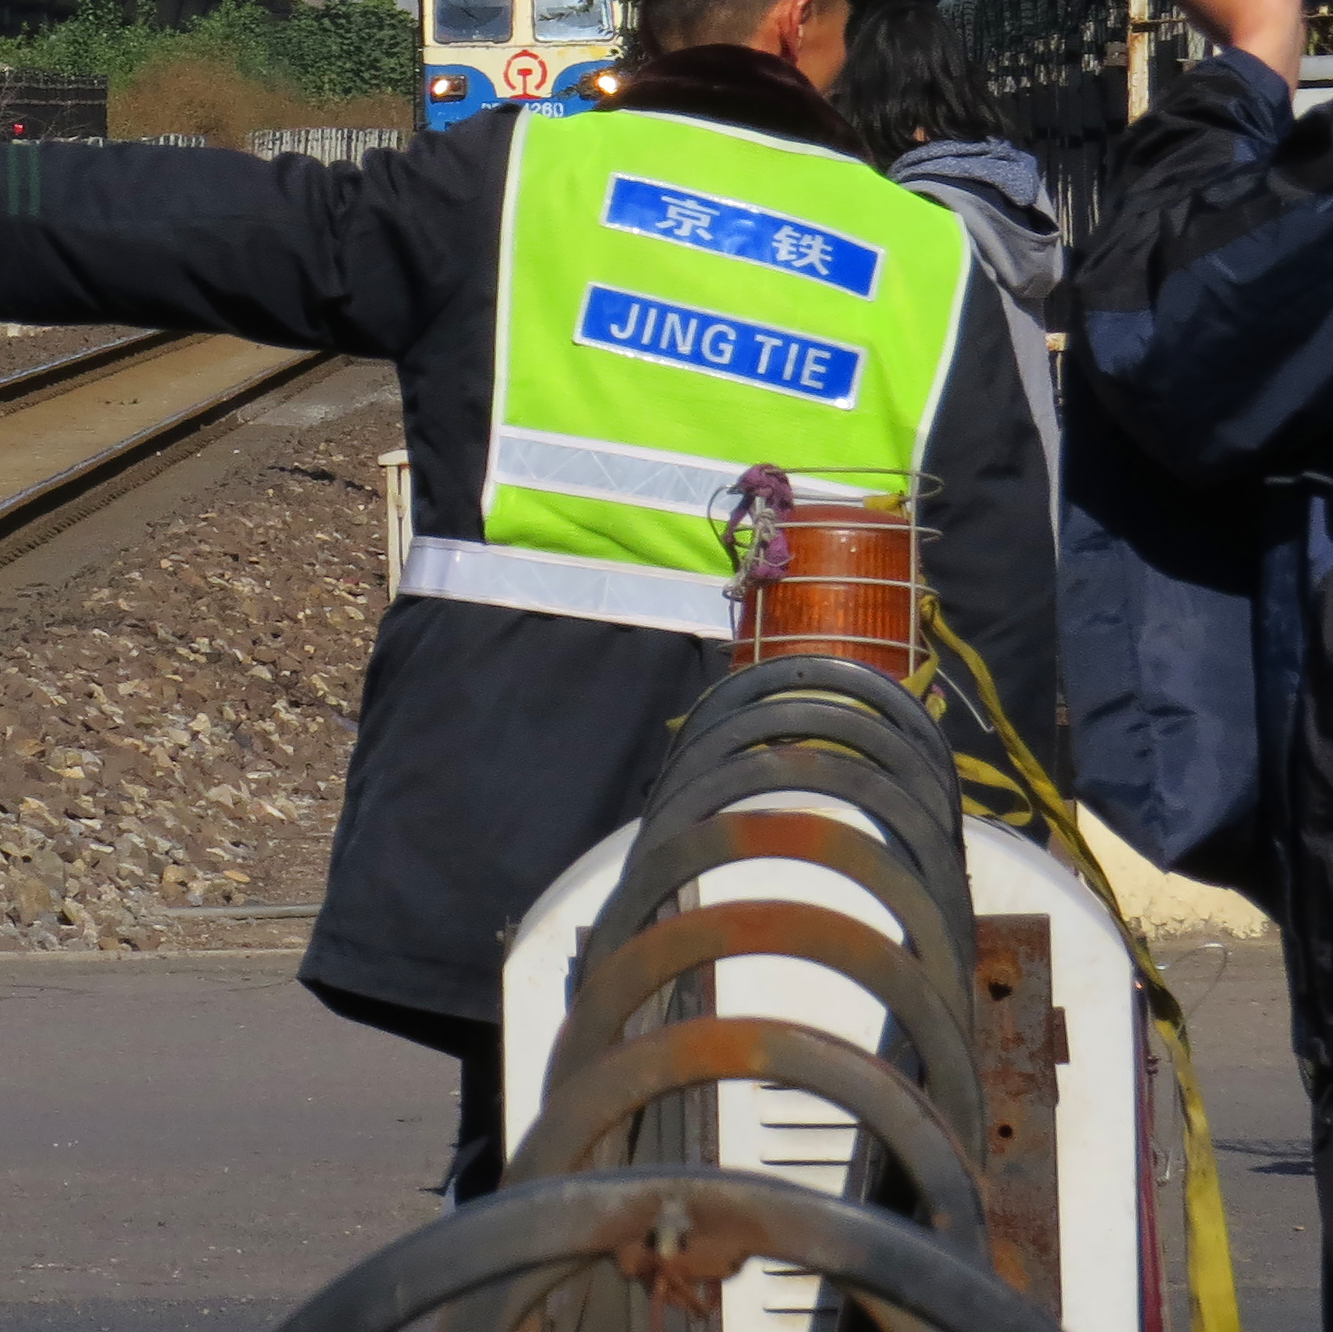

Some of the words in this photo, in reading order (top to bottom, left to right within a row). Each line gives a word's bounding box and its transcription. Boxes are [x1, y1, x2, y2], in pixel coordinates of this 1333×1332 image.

[655, 195, 834, 277] 京铁
[609, 303, 737, 365] JING
[753, 333, 832, 390] TIE
